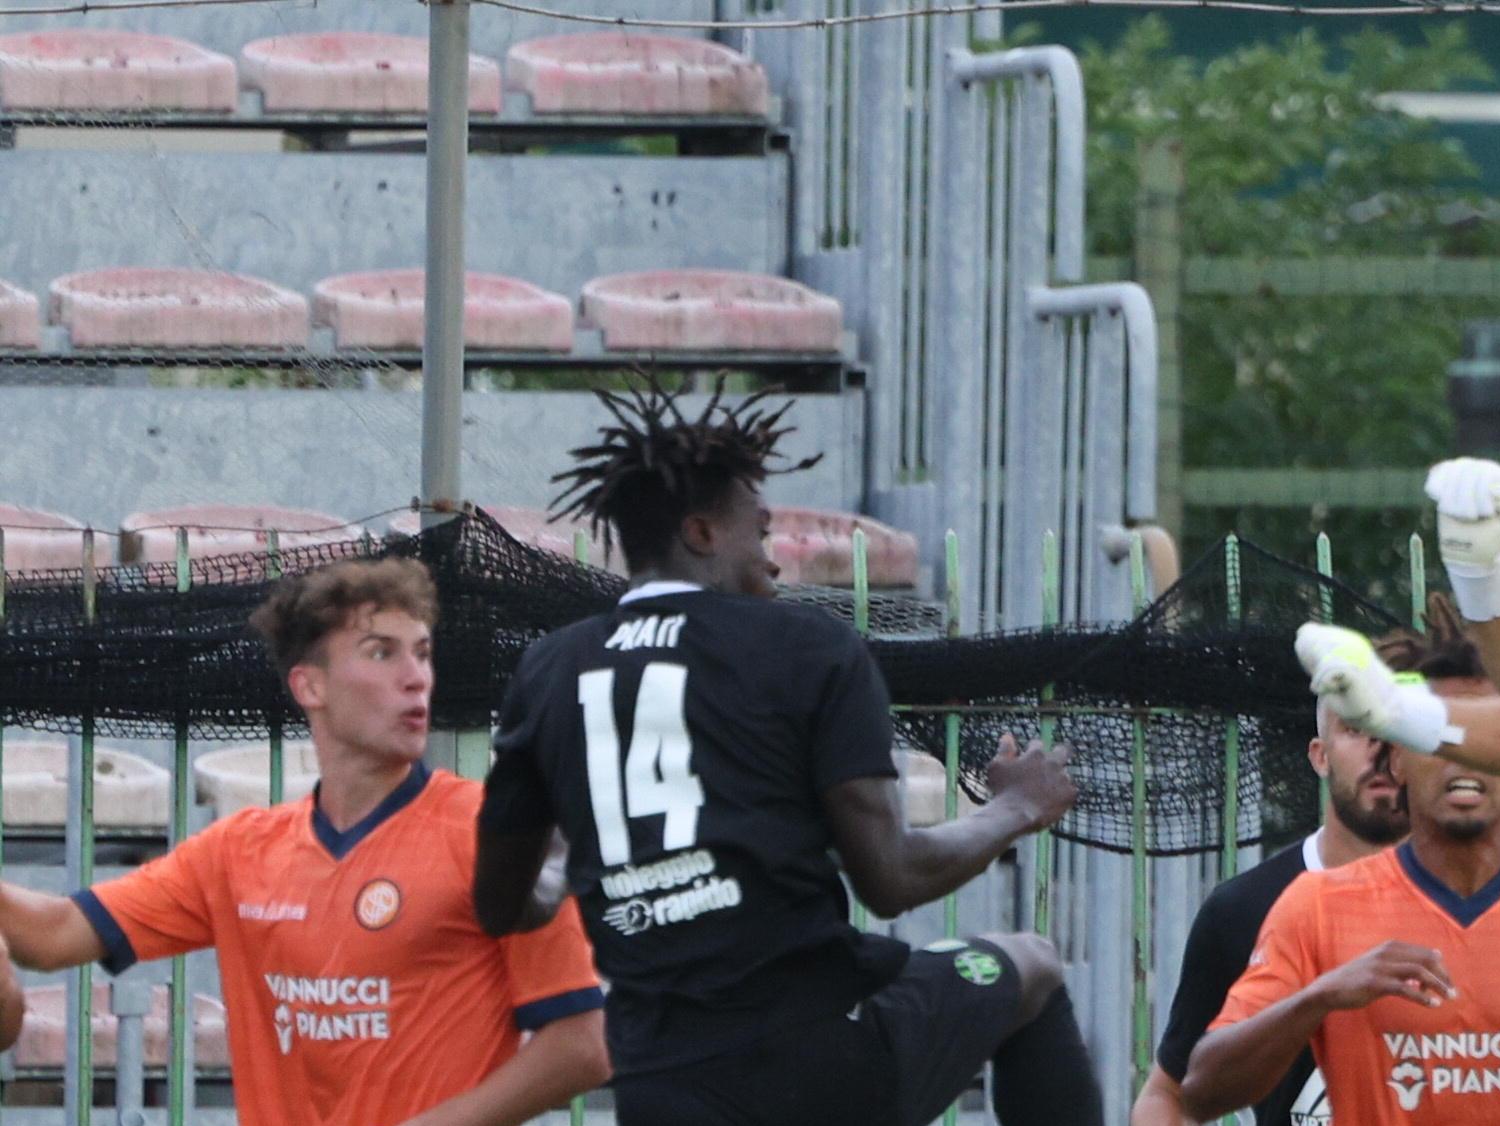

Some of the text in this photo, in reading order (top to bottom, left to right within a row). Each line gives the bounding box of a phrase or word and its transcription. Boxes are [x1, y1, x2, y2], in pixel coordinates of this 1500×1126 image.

[578, 662, 705, 866] 14
[653, 875, 742, 926] rapido
[264, 972, 390, 1006] VANNUCCI
[296, 1010, 390, 1041] PIANTE
